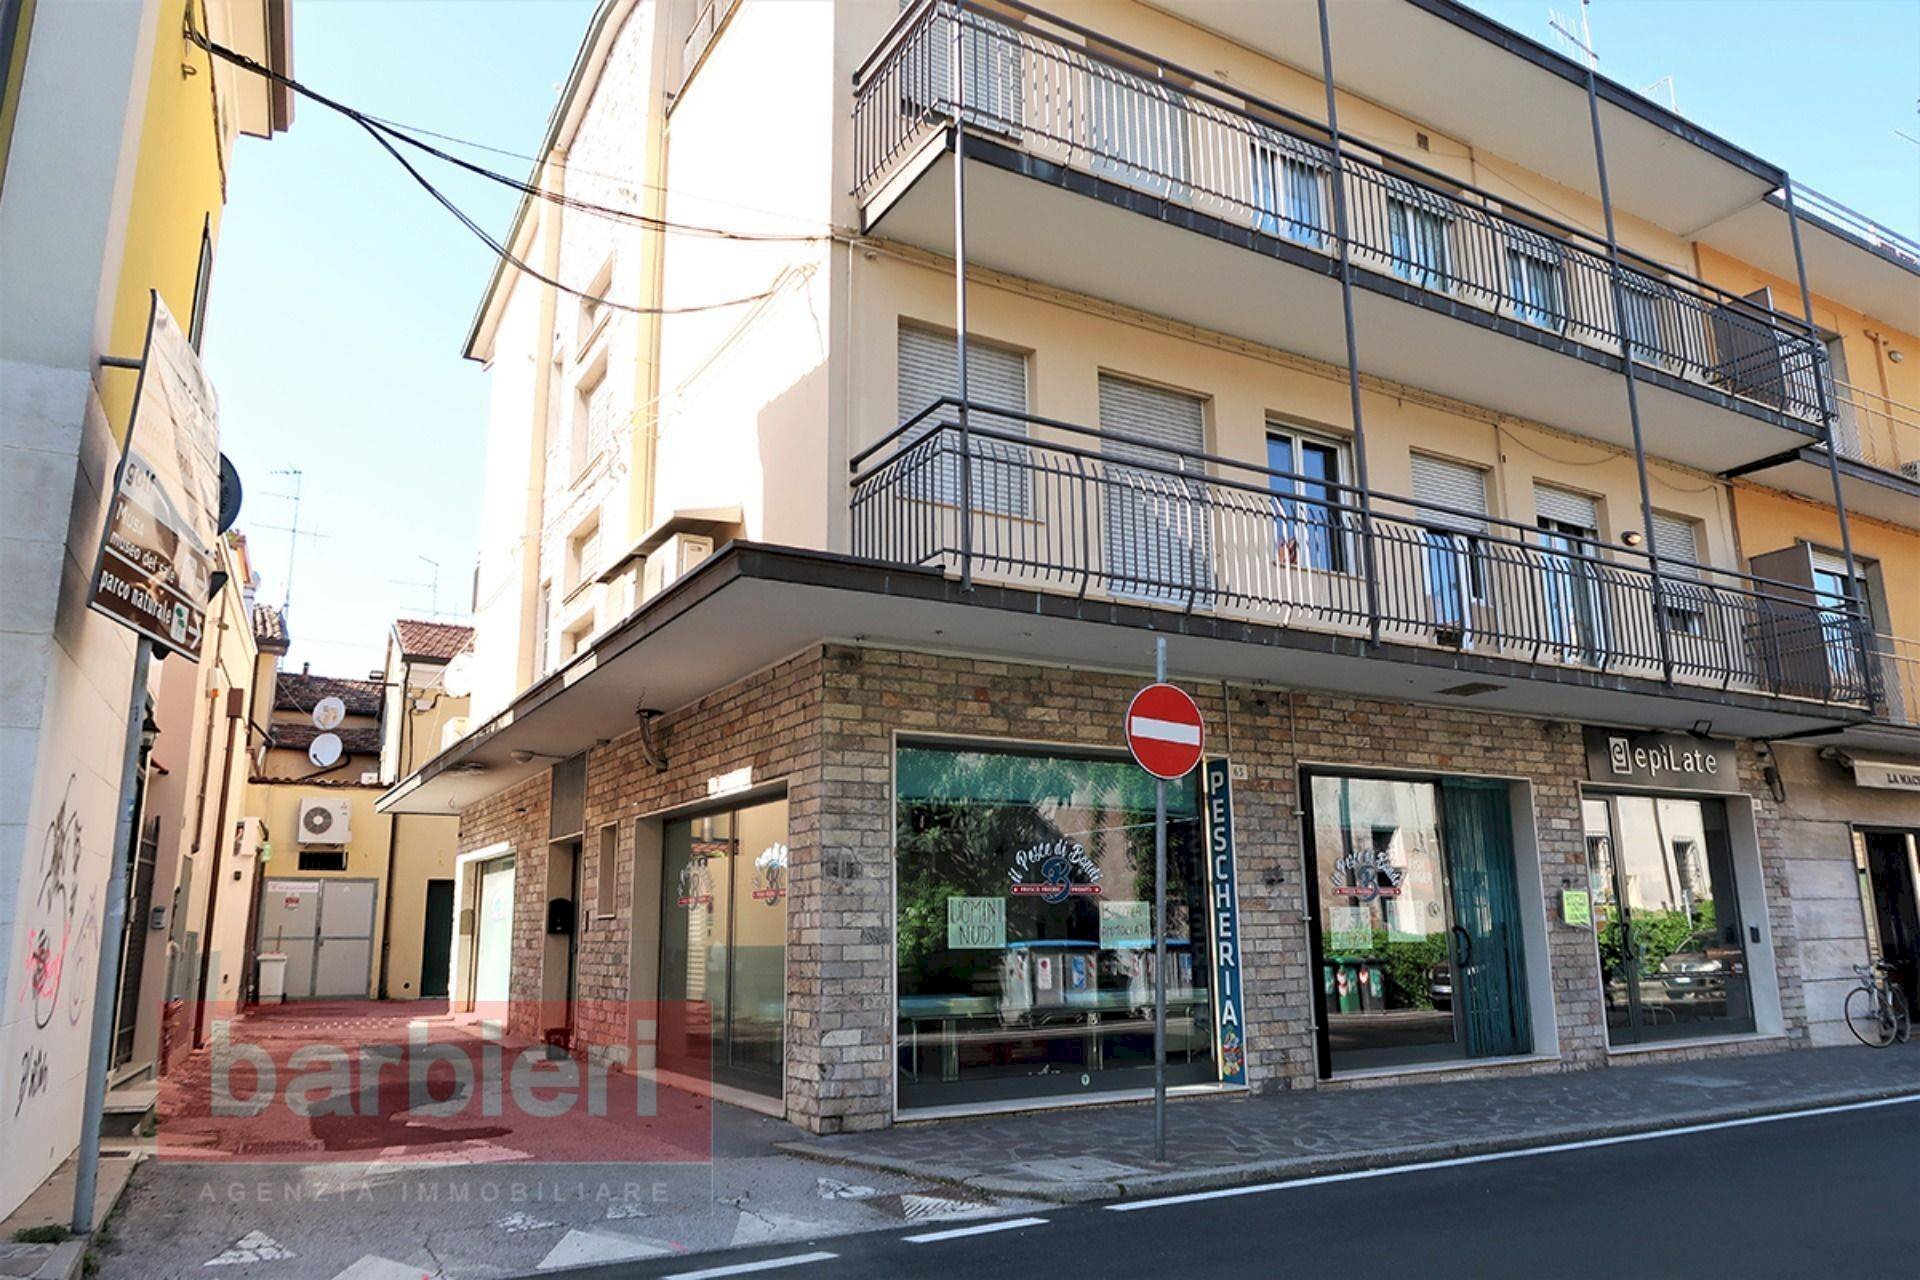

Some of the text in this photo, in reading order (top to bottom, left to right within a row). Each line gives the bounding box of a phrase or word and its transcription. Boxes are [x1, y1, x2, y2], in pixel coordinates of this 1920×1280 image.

[110, 533, 141, 561] museo
[142, 550, 157, 572] del
[98, 569, 172, 626] parco naturale
[1053, 838, 1069, 857] di
[1210, 771, 1238, 1027] PESCHERIA
[959, 925, 996, 945] NUDI
